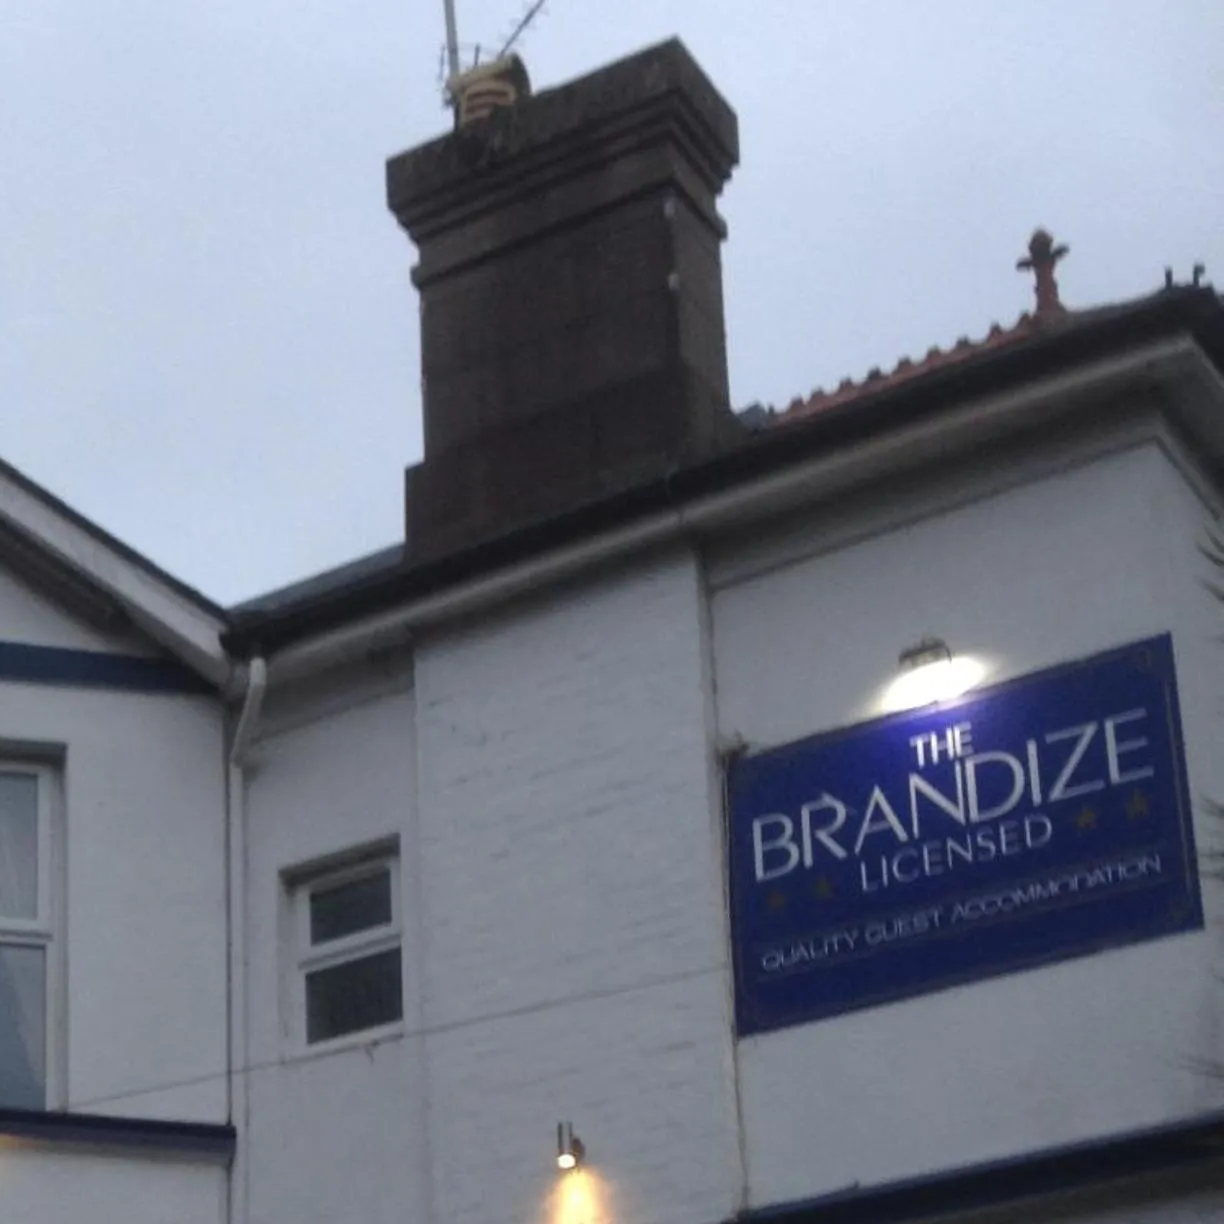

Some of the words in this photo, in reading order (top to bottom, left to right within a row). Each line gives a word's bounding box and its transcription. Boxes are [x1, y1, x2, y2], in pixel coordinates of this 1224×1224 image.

[910, 721, 973, 767] THE
[752, 708, 1155, 883] BRANDIZE
[860, 814, 1053, 892] LICENSED
[761, 929, 860, 972] QUALITY
[865, 906, 944, 945] GUEST
[950, 854, 1162, 924] ACCOMMODATION
